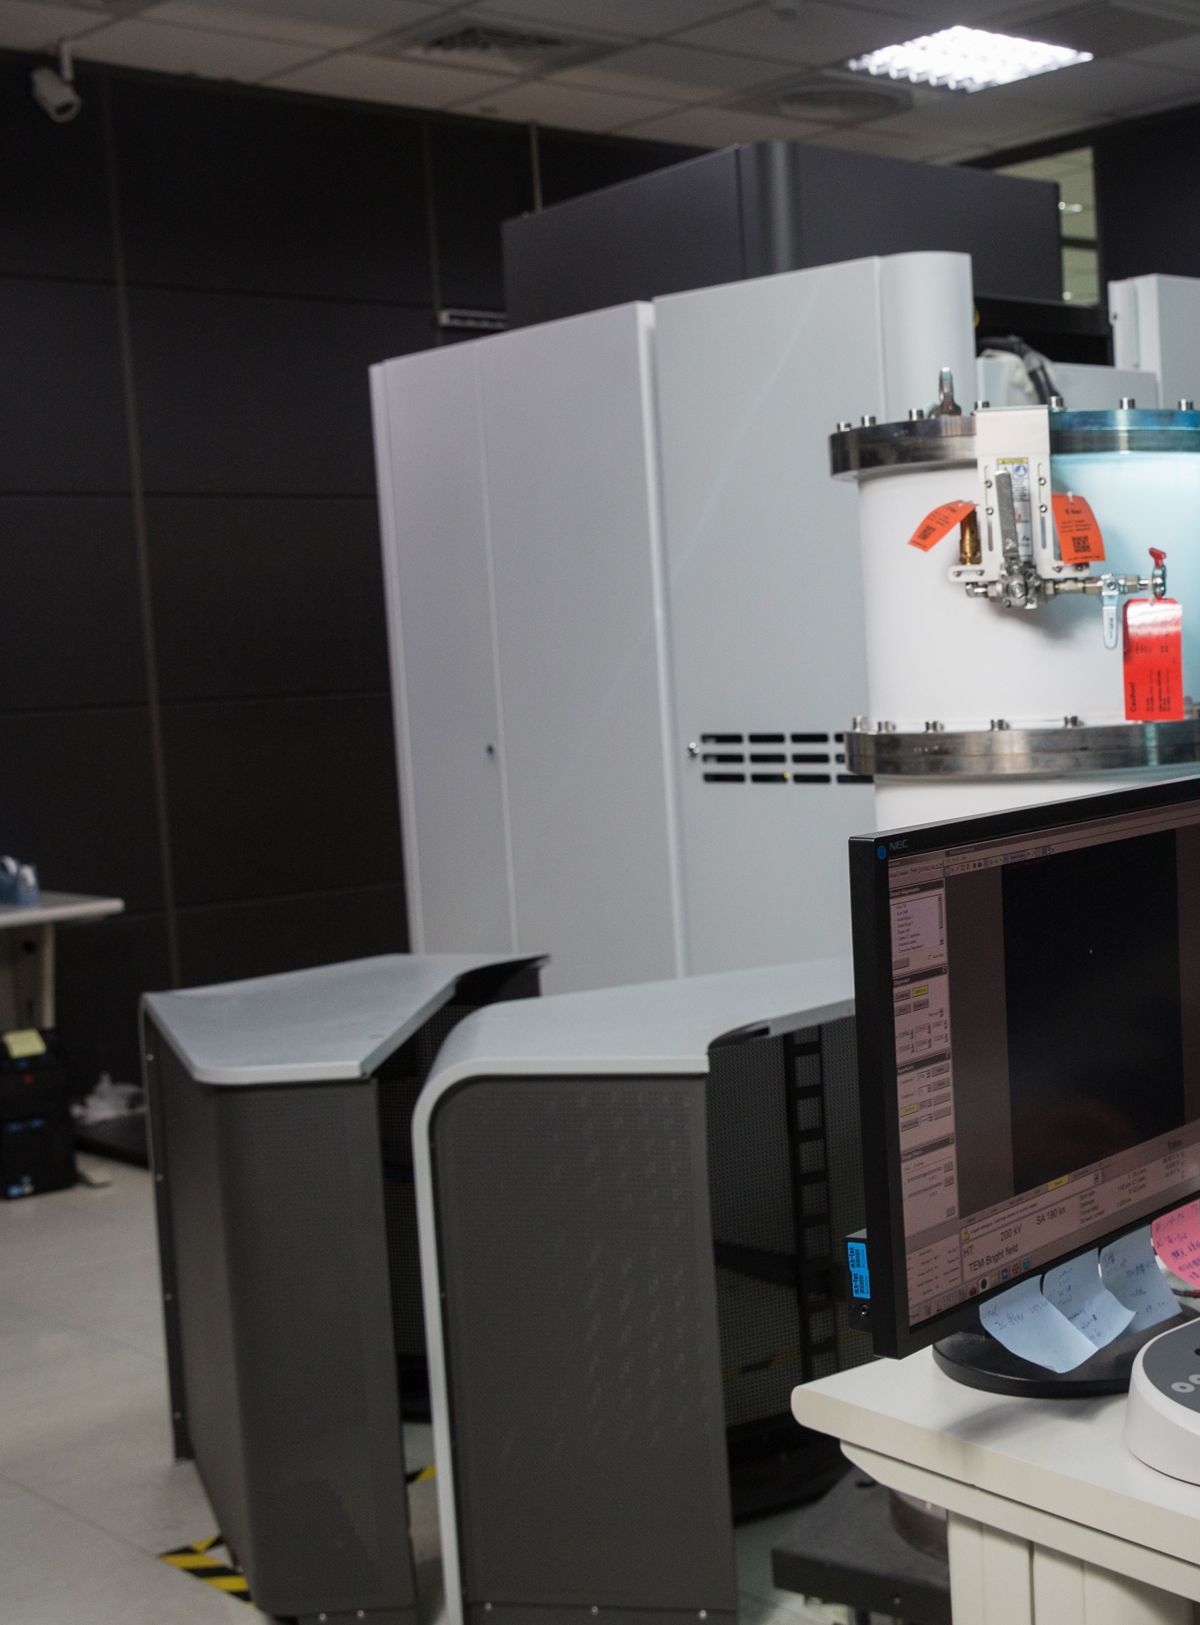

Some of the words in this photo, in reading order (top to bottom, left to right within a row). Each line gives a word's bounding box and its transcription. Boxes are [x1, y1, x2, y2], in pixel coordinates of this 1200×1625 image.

[889, 839, 908, 850] NEC
[1000, 1229, 1012, 1242] 200
[969, 1258, 985, 1273] TEM
[985, 1249, 1004, 1266] Bright
[1005, 1243, 1018, 1256] field
